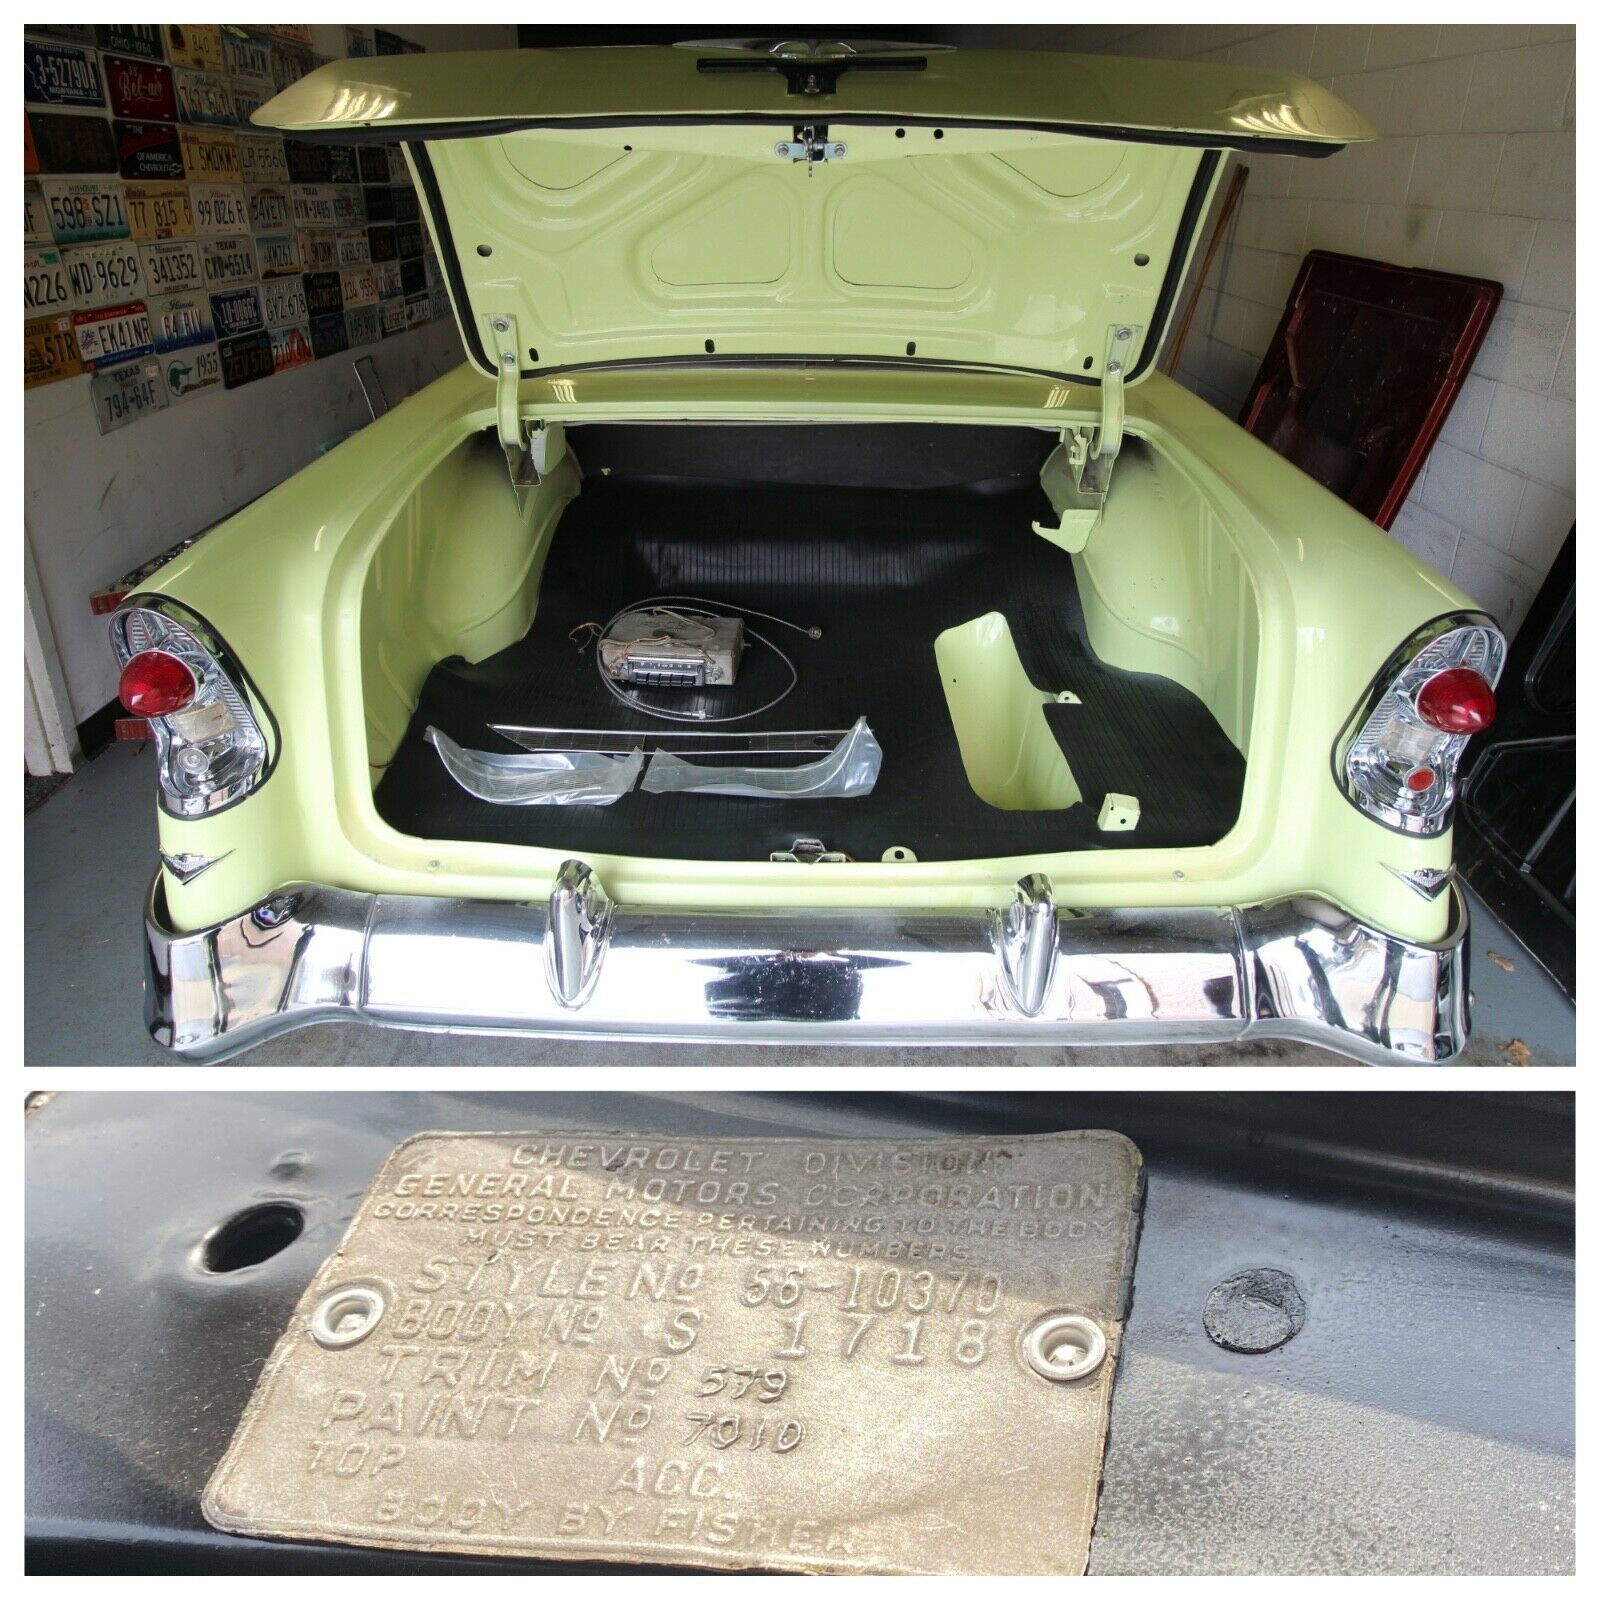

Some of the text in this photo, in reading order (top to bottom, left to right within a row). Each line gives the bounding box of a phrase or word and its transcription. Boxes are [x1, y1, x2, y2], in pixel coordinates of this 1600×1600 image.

[50, 196, 86, 230] 598
[153, 199, 178, 227] 815
[215, 240, 237, 251] TEXAS
[148, 253, 198, 285] 341352
[98, 316, 153, 354] EK41NR
[114, 364, 141, 382] TEXAS
[196, 351, 219, 379] 1955
[511, 1144, 1000, 1176] CHEVROLET DIVISION
[394, 1173, 1112, 1211] GENERAL MOTORS CORPORATION
[372, 1202, 1115, 1240] CORRESPONDENCE PERTAINING TO THE BODY
[462, 1227, 973, 1262] MUST BEAR THESE NUMBERS
[411, 1253, 618, 1300] STYLE
[391, 1298, 536, 1342] BODY
[664, 1306, 702, 1354] S
[379, 1344, 560, 1390] TRIM
[695, 1364, 790, 1401] 579
[318, 1388, 544, 1438] PAINT
[678, 1410, 808, 1454] 7010
[306, 1440, 408, 1478] TOP
[372, 1489, 858, 1553] BODY BY FISHER
